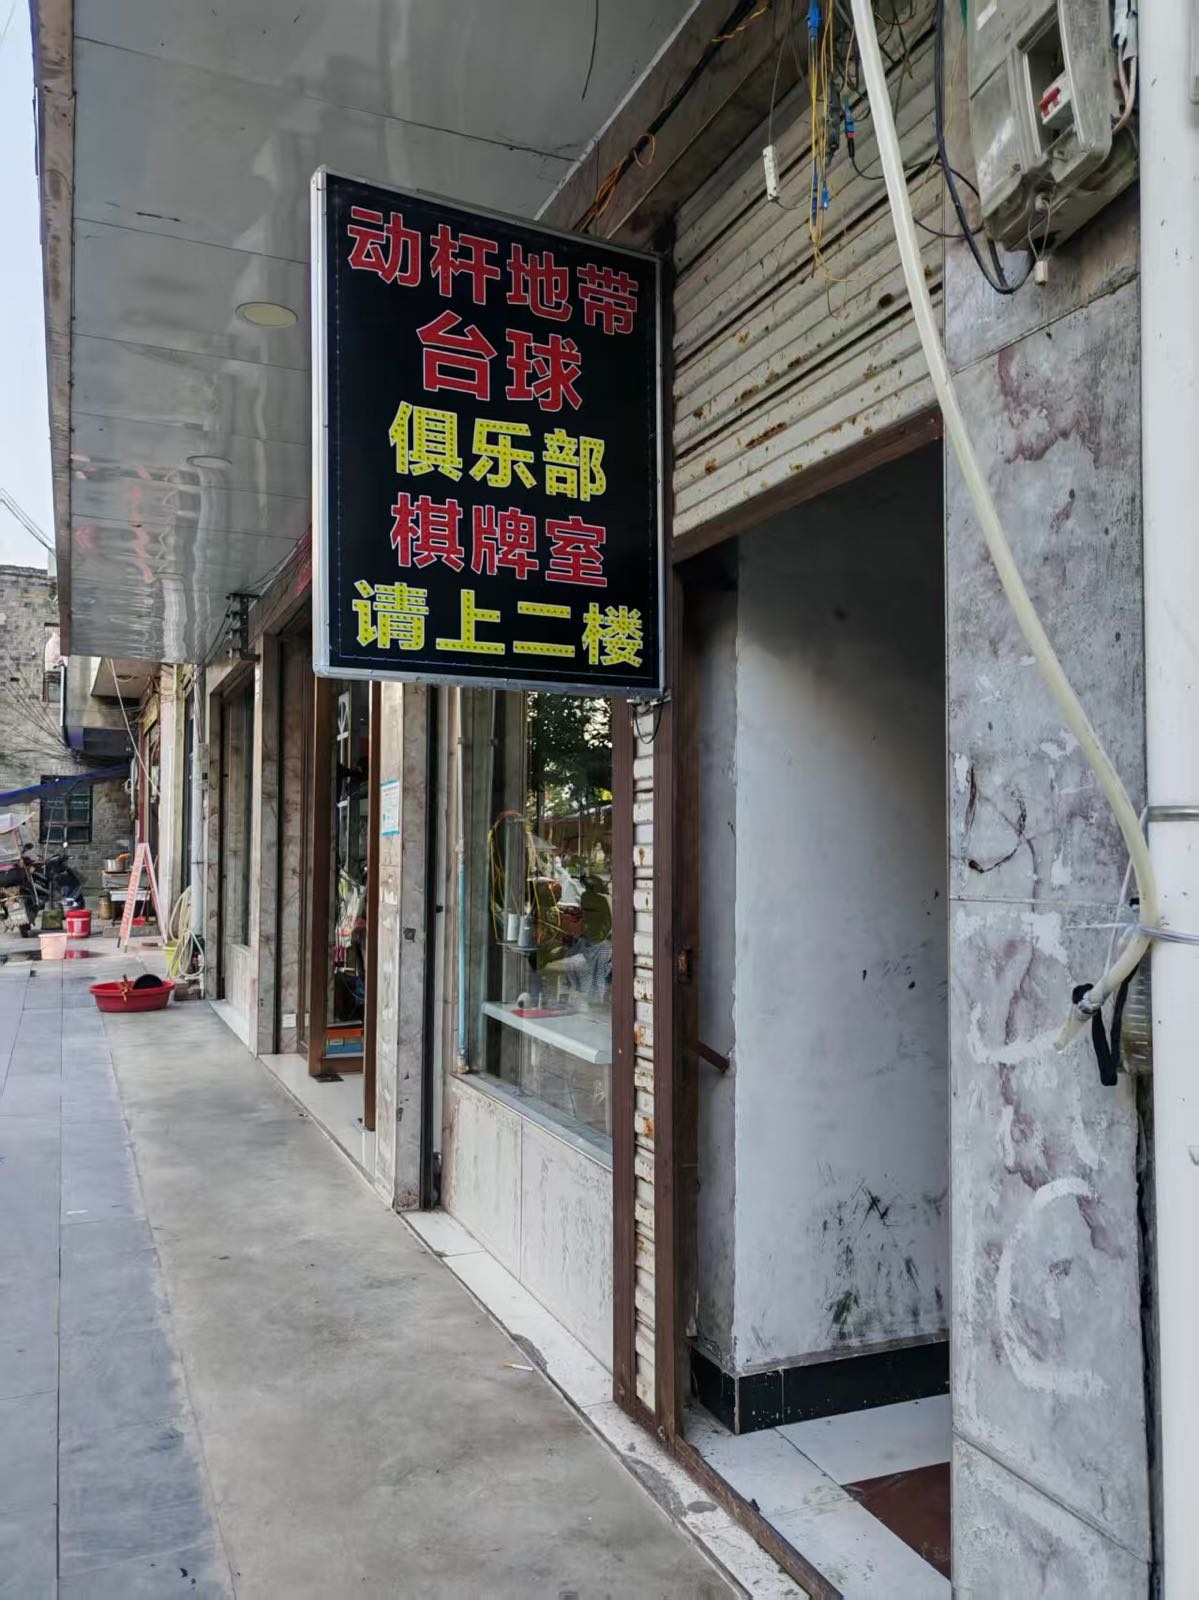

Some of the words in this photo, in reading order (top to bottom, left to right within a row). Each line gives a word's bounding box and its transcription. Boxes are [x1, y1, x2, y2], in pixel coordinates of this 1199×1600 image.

[347, 206, 639, 335] 动杆地带
[416, 310, 582, 412] 台球
[388, 401, 607, 502] 俱乐部
[390, 492, 607, 587] 棋牌室
[352, 580, 643, 667] 请上二楼
